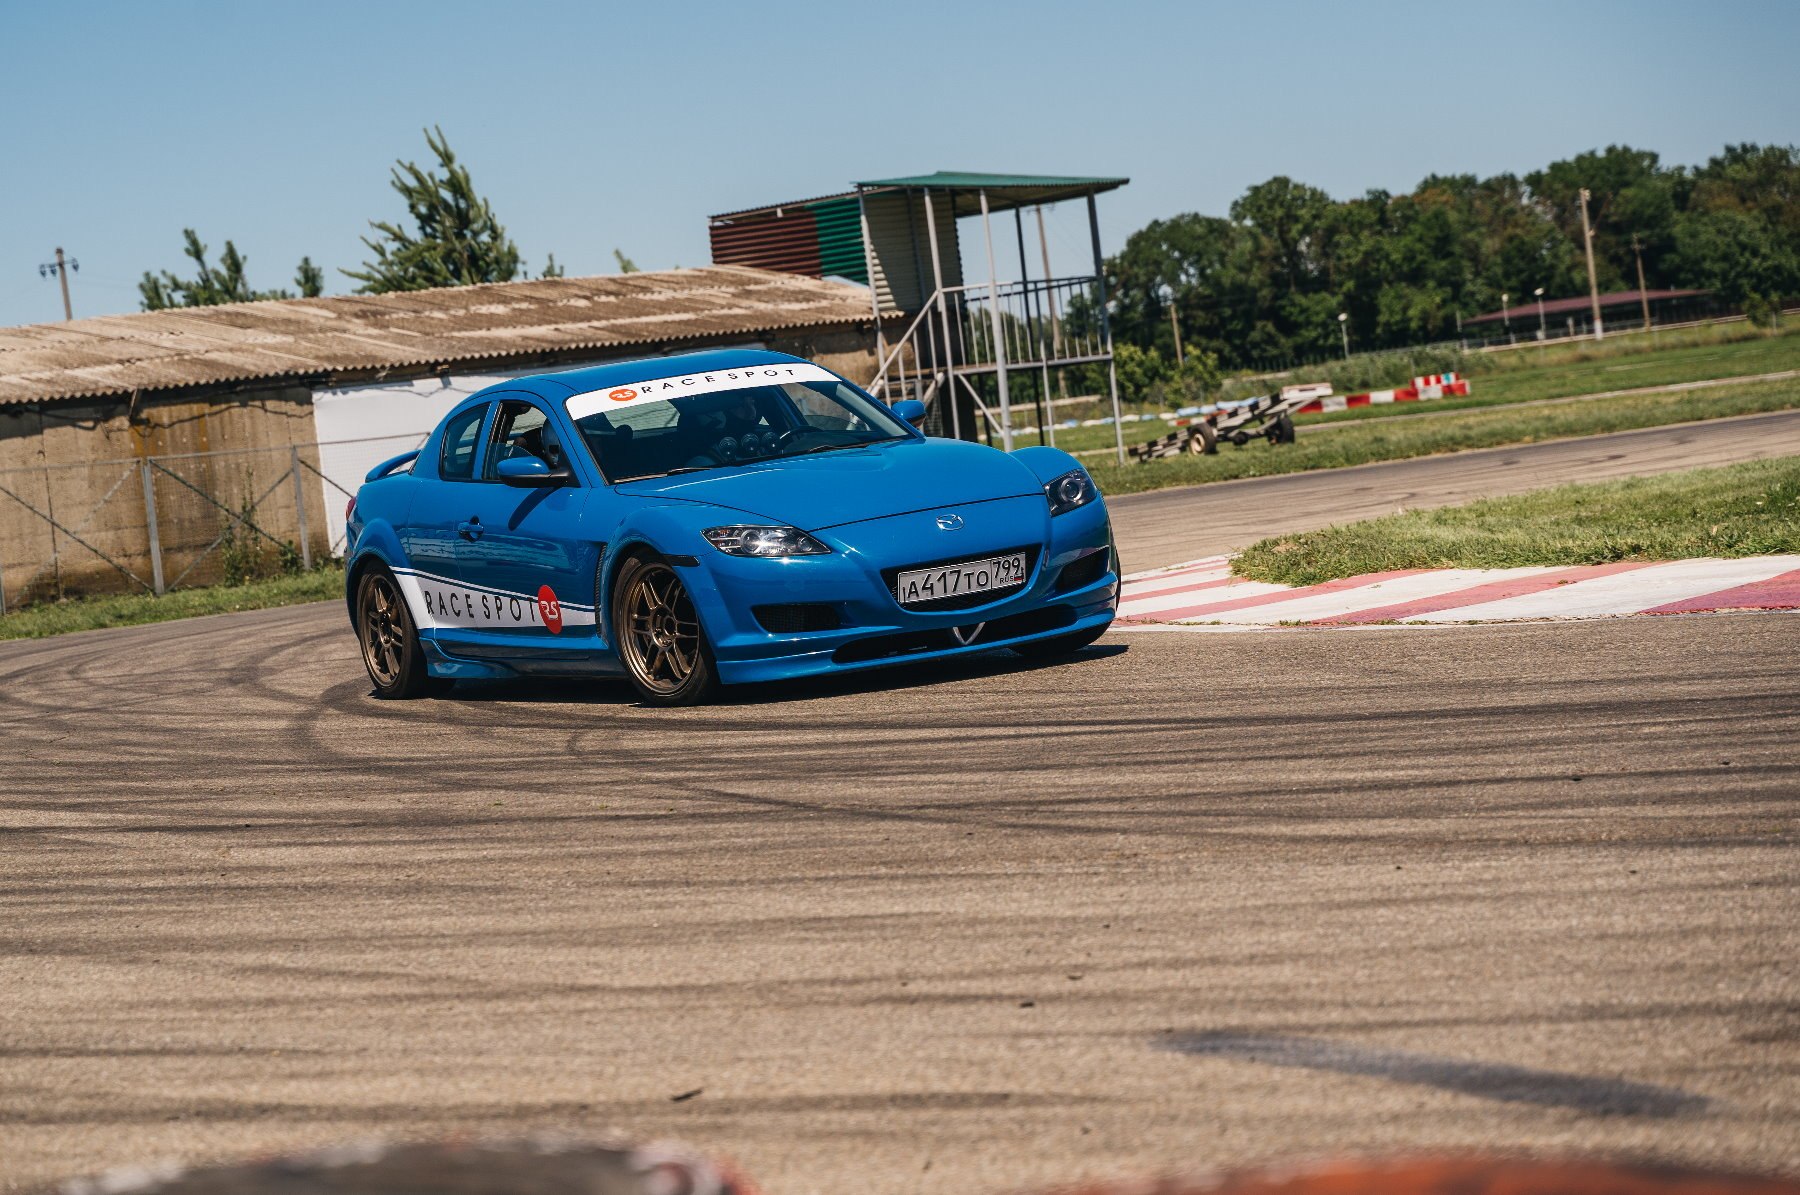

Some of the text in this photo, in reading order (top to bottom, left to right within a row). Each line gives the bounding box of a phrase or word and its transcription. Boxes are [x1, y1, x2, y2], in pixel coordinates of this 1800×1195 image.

[907, 557, 1021, 598] A417TO 799
[1000, 576, 1014, 585] RUS
